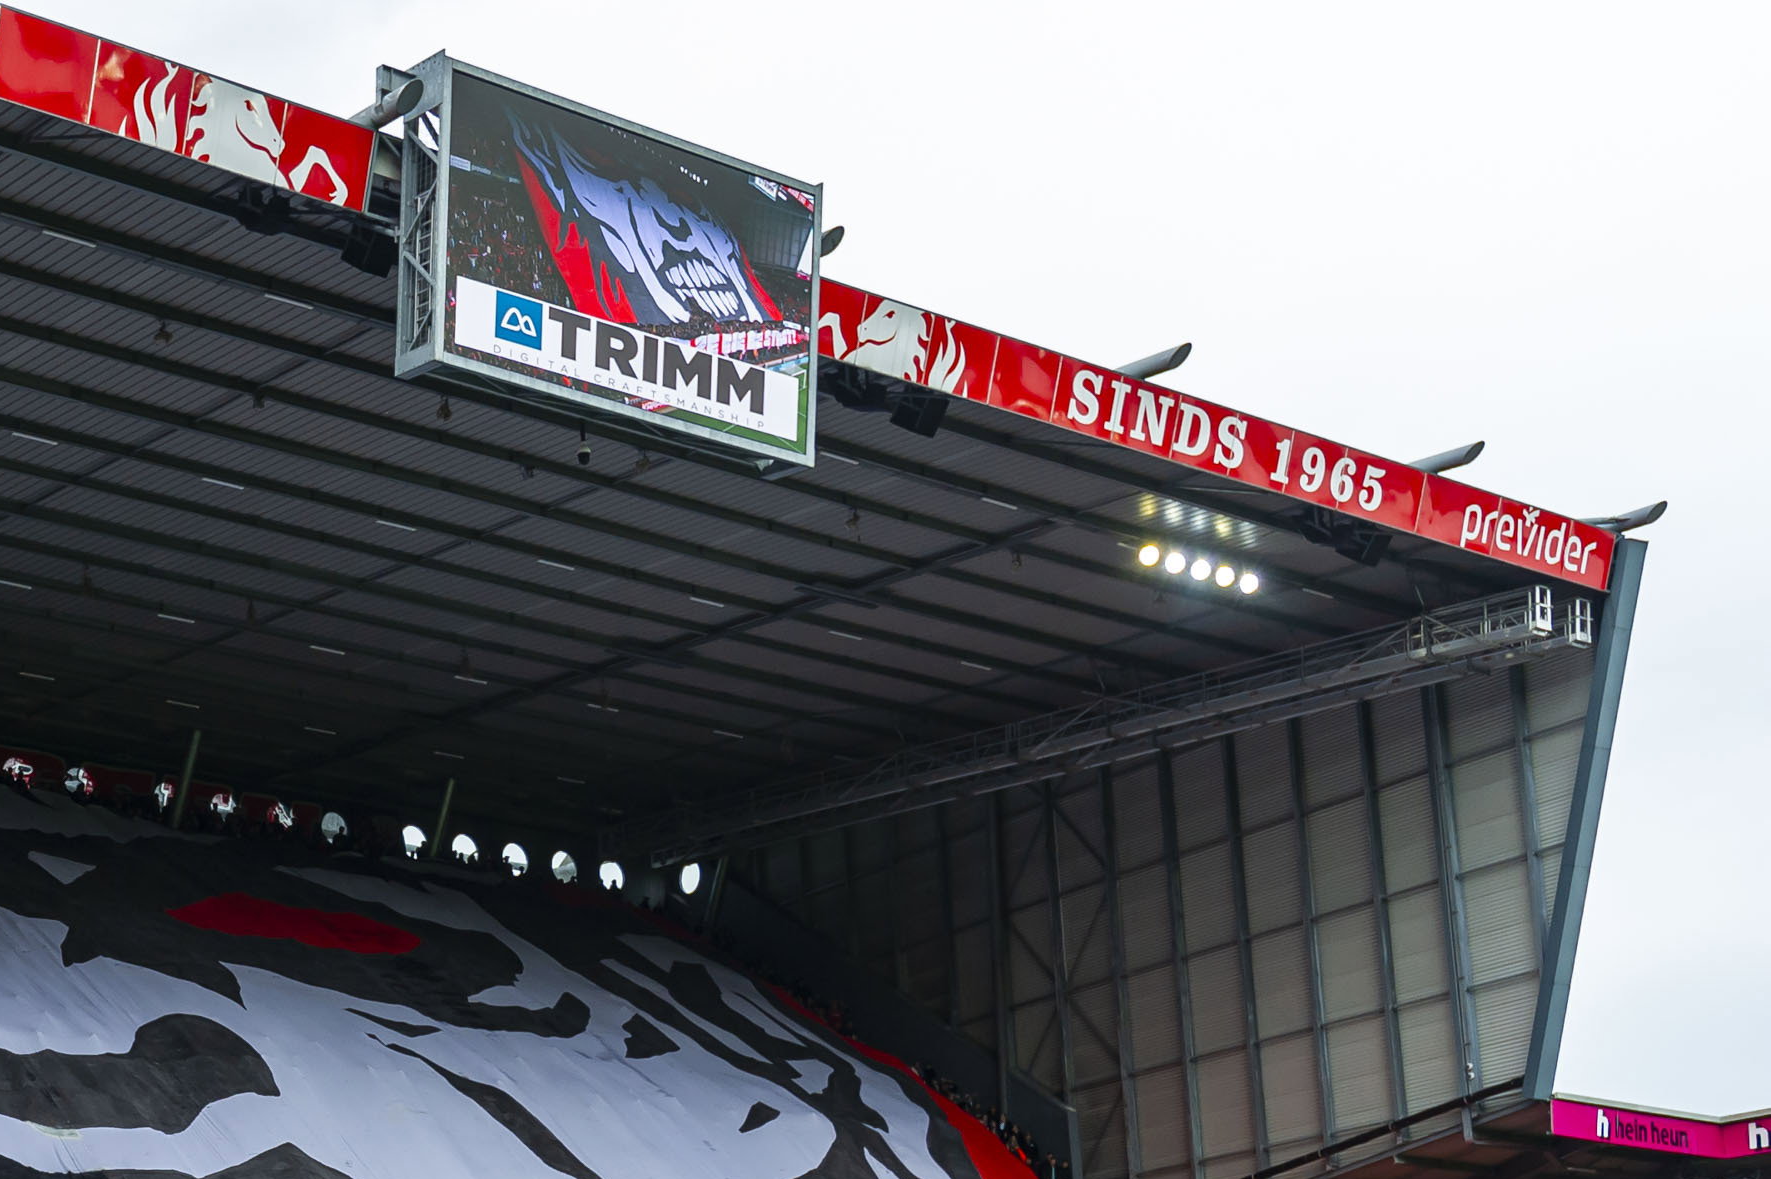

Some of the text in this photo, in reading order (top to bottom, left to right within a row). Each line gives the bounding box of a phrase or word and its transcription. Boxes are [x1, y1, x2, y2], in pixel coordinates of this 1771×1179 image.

[493, 344, 764, 428] DIGITAL CRAFTSMANSHIP
[548, 306, 766, 415] TRIMM
[1067, 369, 1386, 512] SINDS 1965
[1460, 504, 1597, 574] previder
[1615, 1110, 1648, 1143] hein
